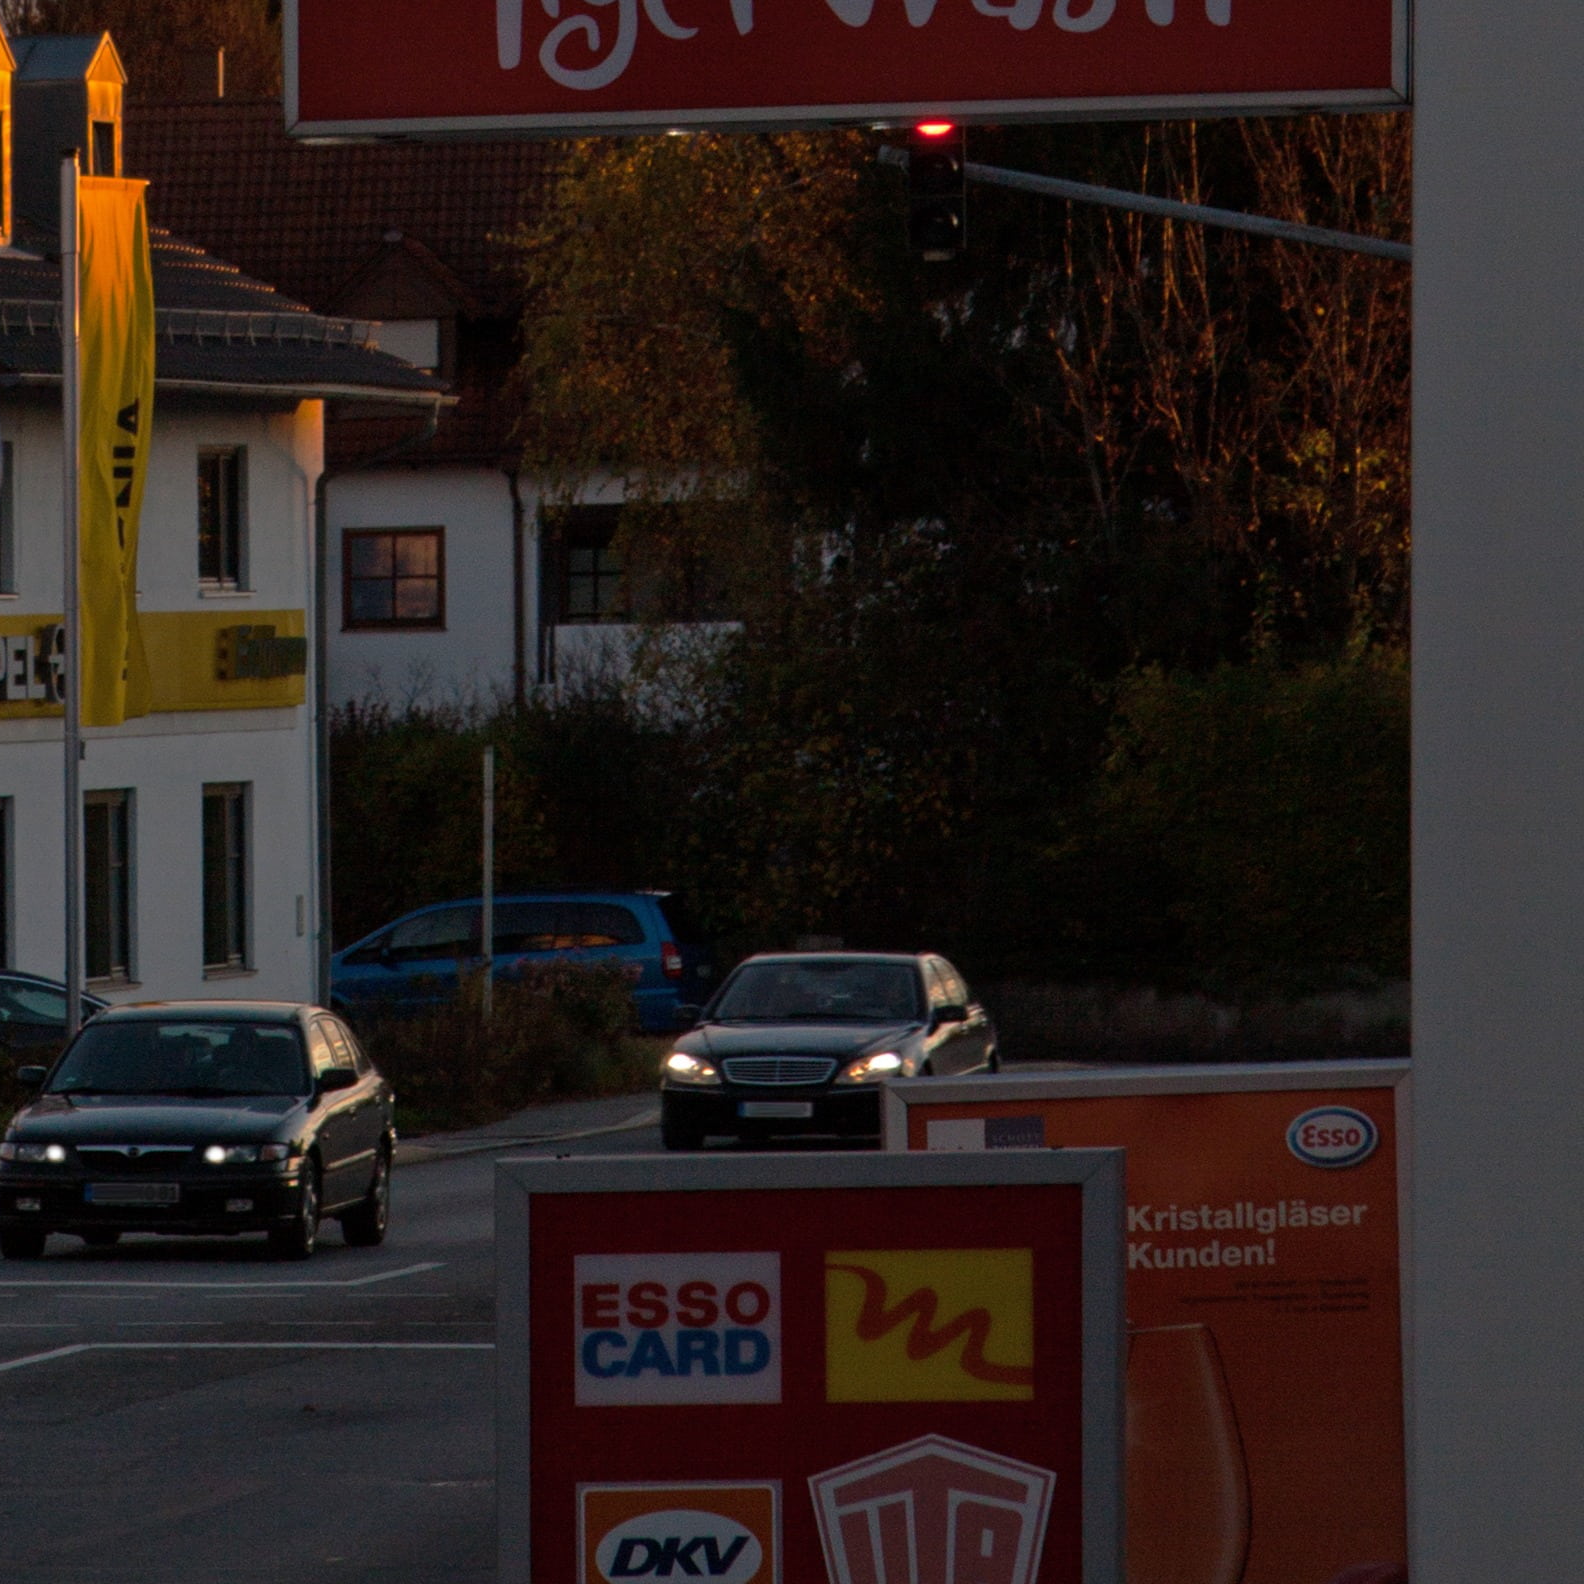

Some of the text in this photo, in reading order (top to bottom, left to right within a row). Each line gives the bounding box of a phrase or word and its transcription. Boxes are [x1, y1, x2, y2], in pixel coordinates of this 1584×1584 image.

[1127, 1199, 1369, 1234] Kristallgläser
[1127, 1238, 1276, 1270] Kunden!
[581, 1280, 771, 1329] ESSO
[581, 1329, 771, 1377] CARD
[609, 1535, 750, 1577] DKV
